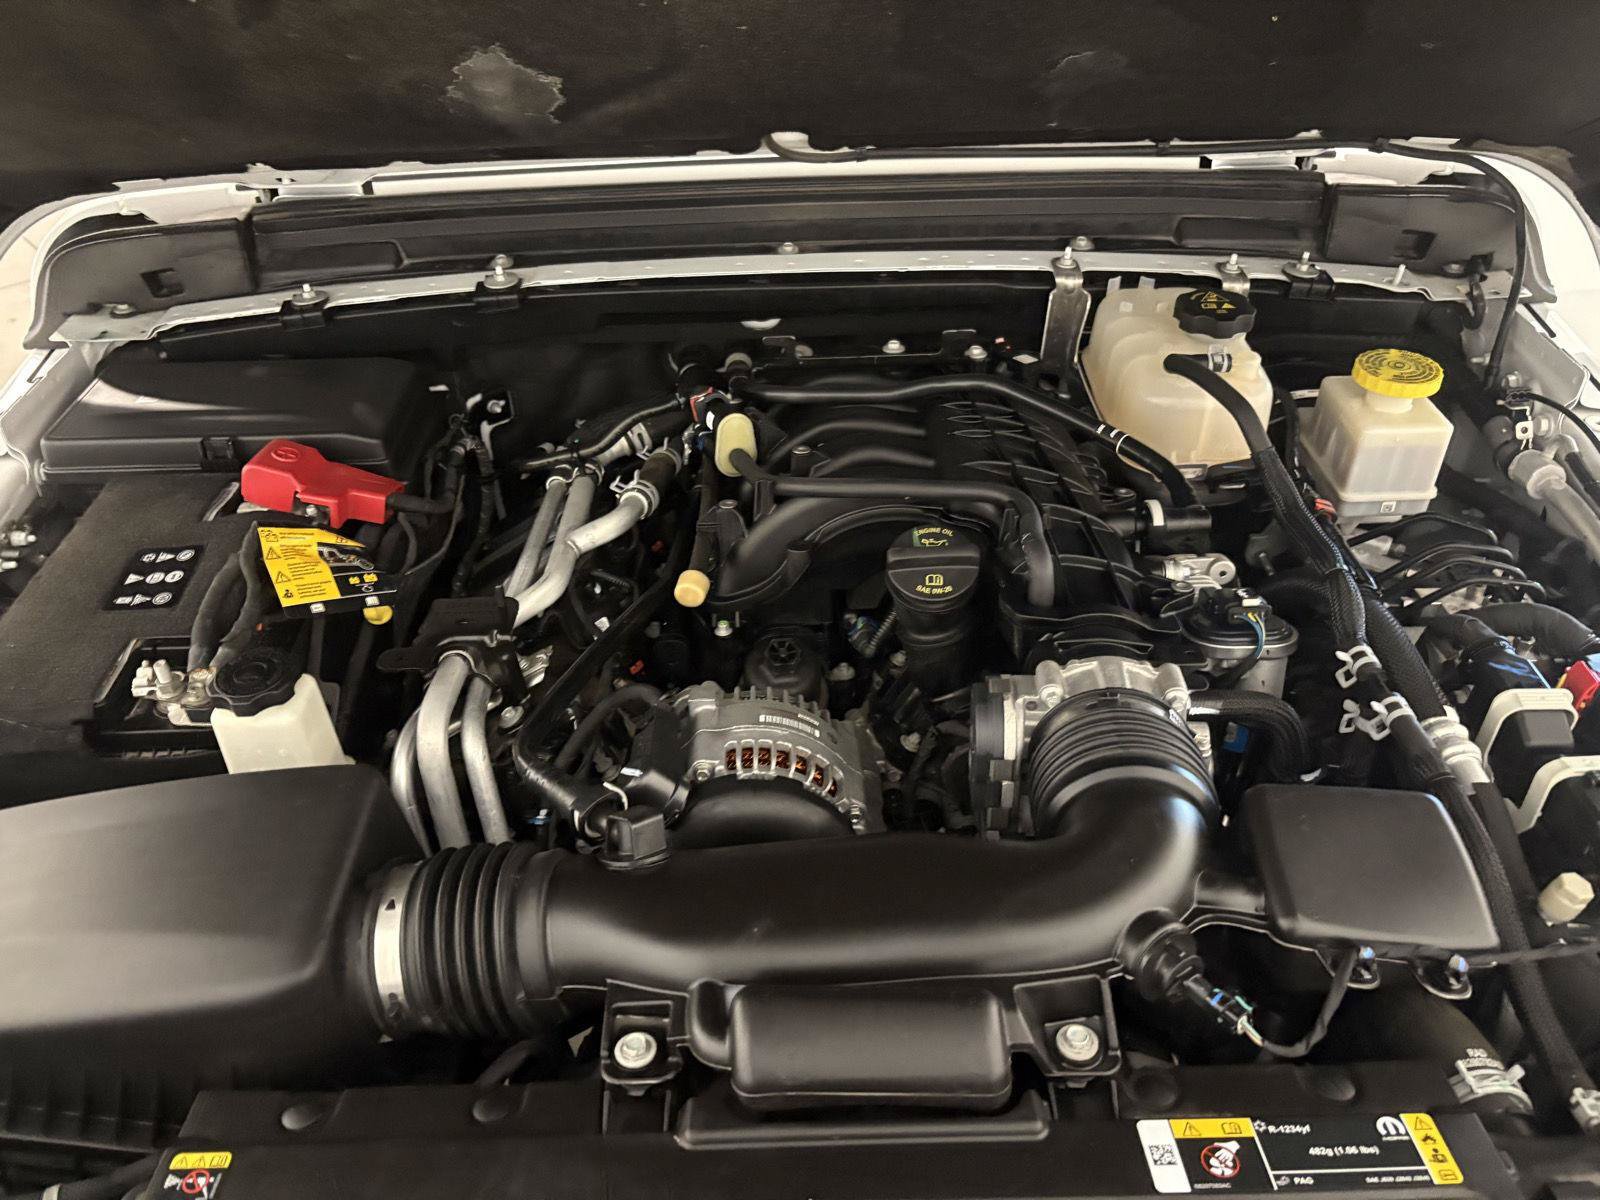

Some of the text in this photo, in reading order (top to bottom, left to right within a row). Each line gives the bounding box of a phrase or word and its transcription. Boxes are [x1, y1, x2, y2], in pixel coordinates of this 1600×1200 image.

[914, 527, 954, 537] ENGINE OIL
[915, 584, 931, 594] SAE
